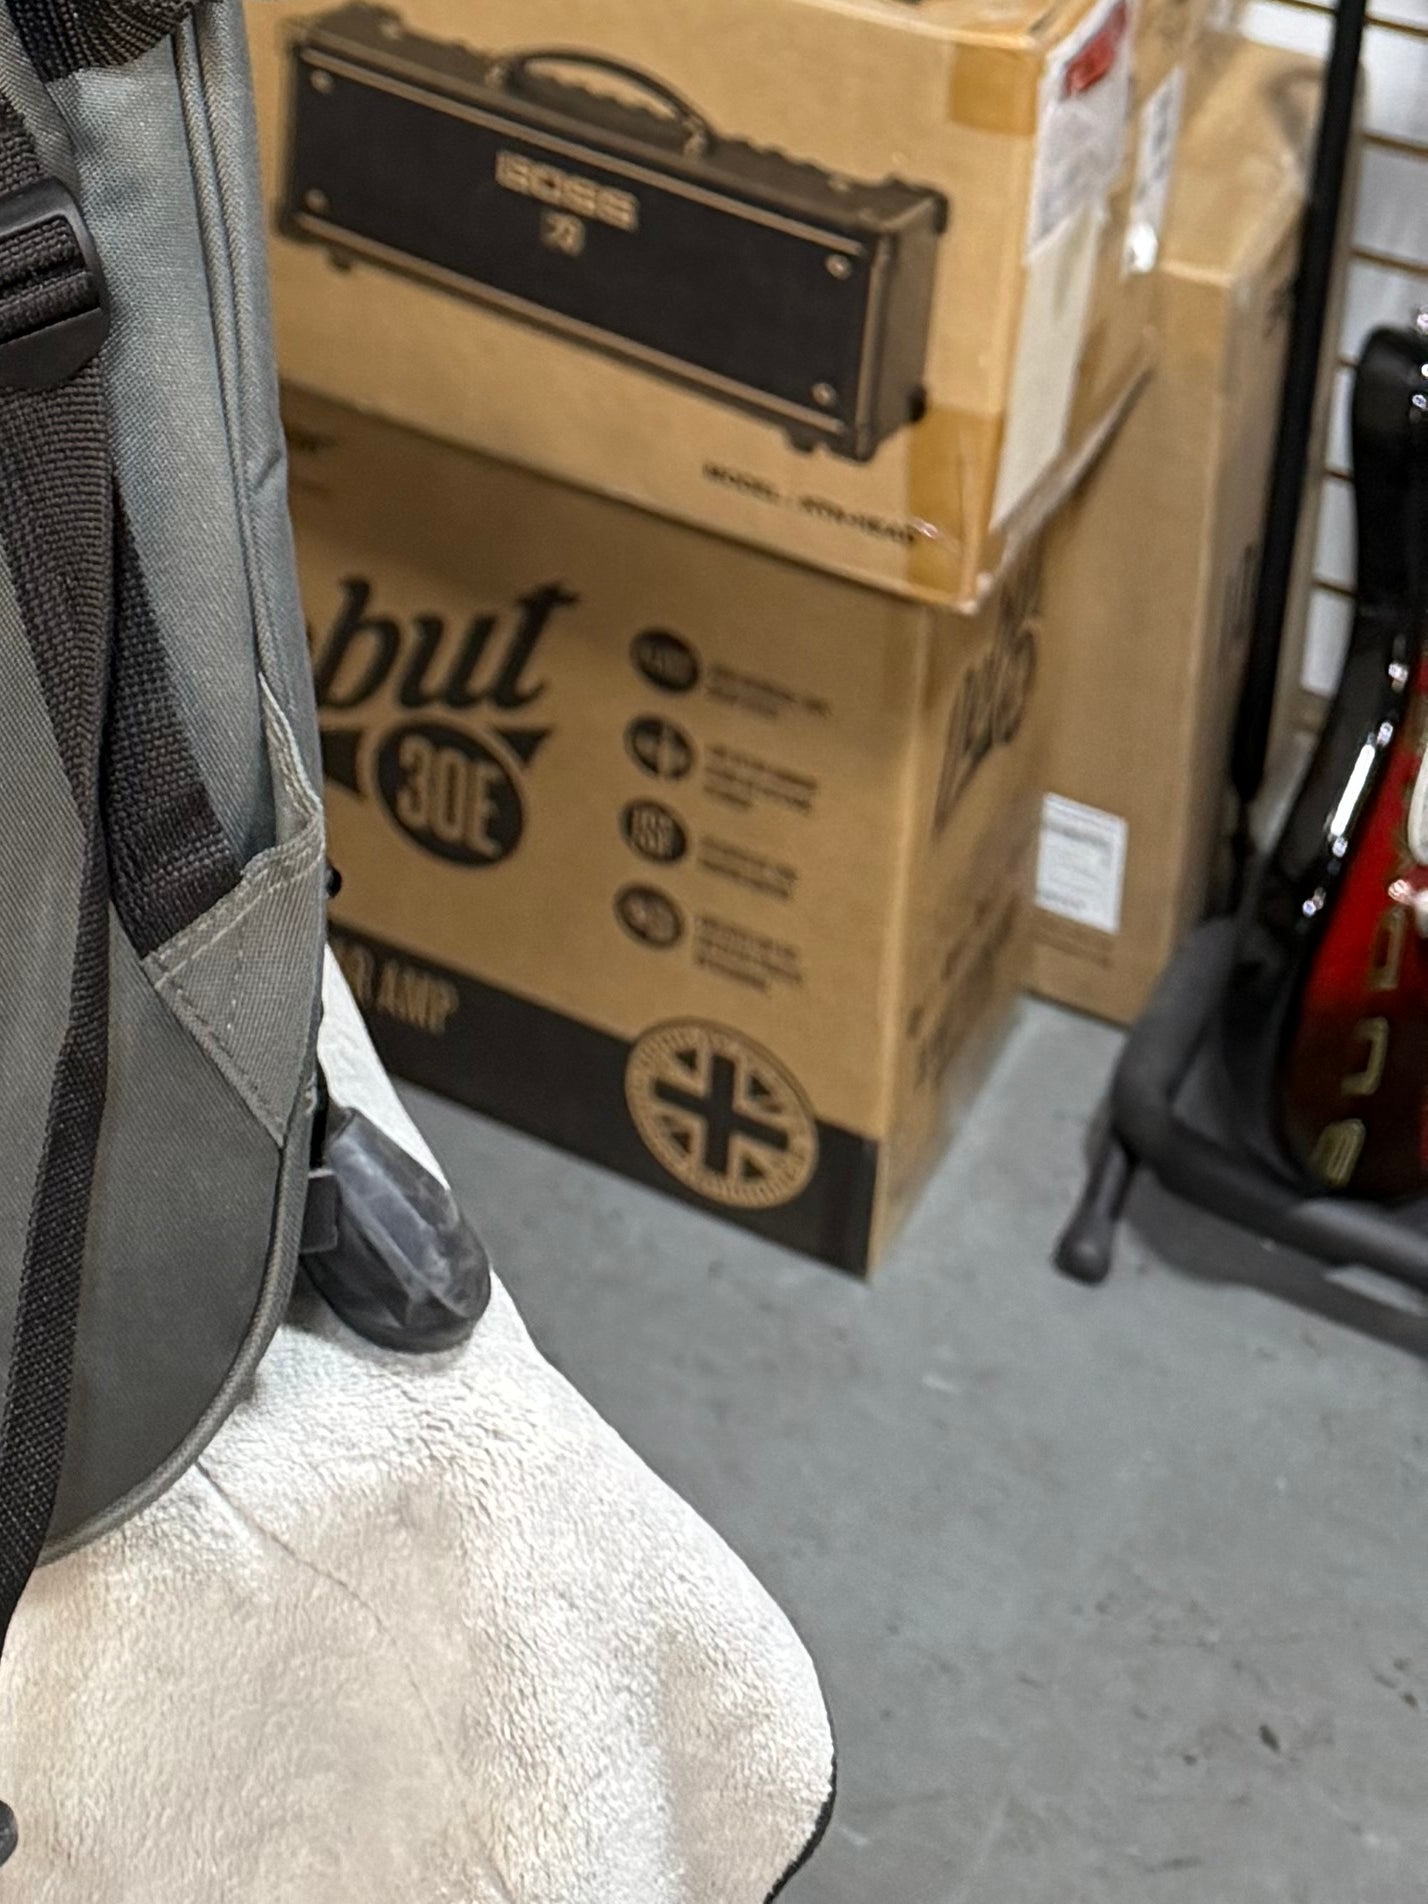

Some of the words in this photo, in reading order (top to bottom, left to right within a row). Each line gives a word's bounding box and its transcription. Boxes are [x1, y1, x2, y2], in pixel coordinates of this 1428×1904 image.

[495, 148, 641, 234] BOSS
[307, 574, 579, 710] but
[396, 733, 503, 860] 30E
